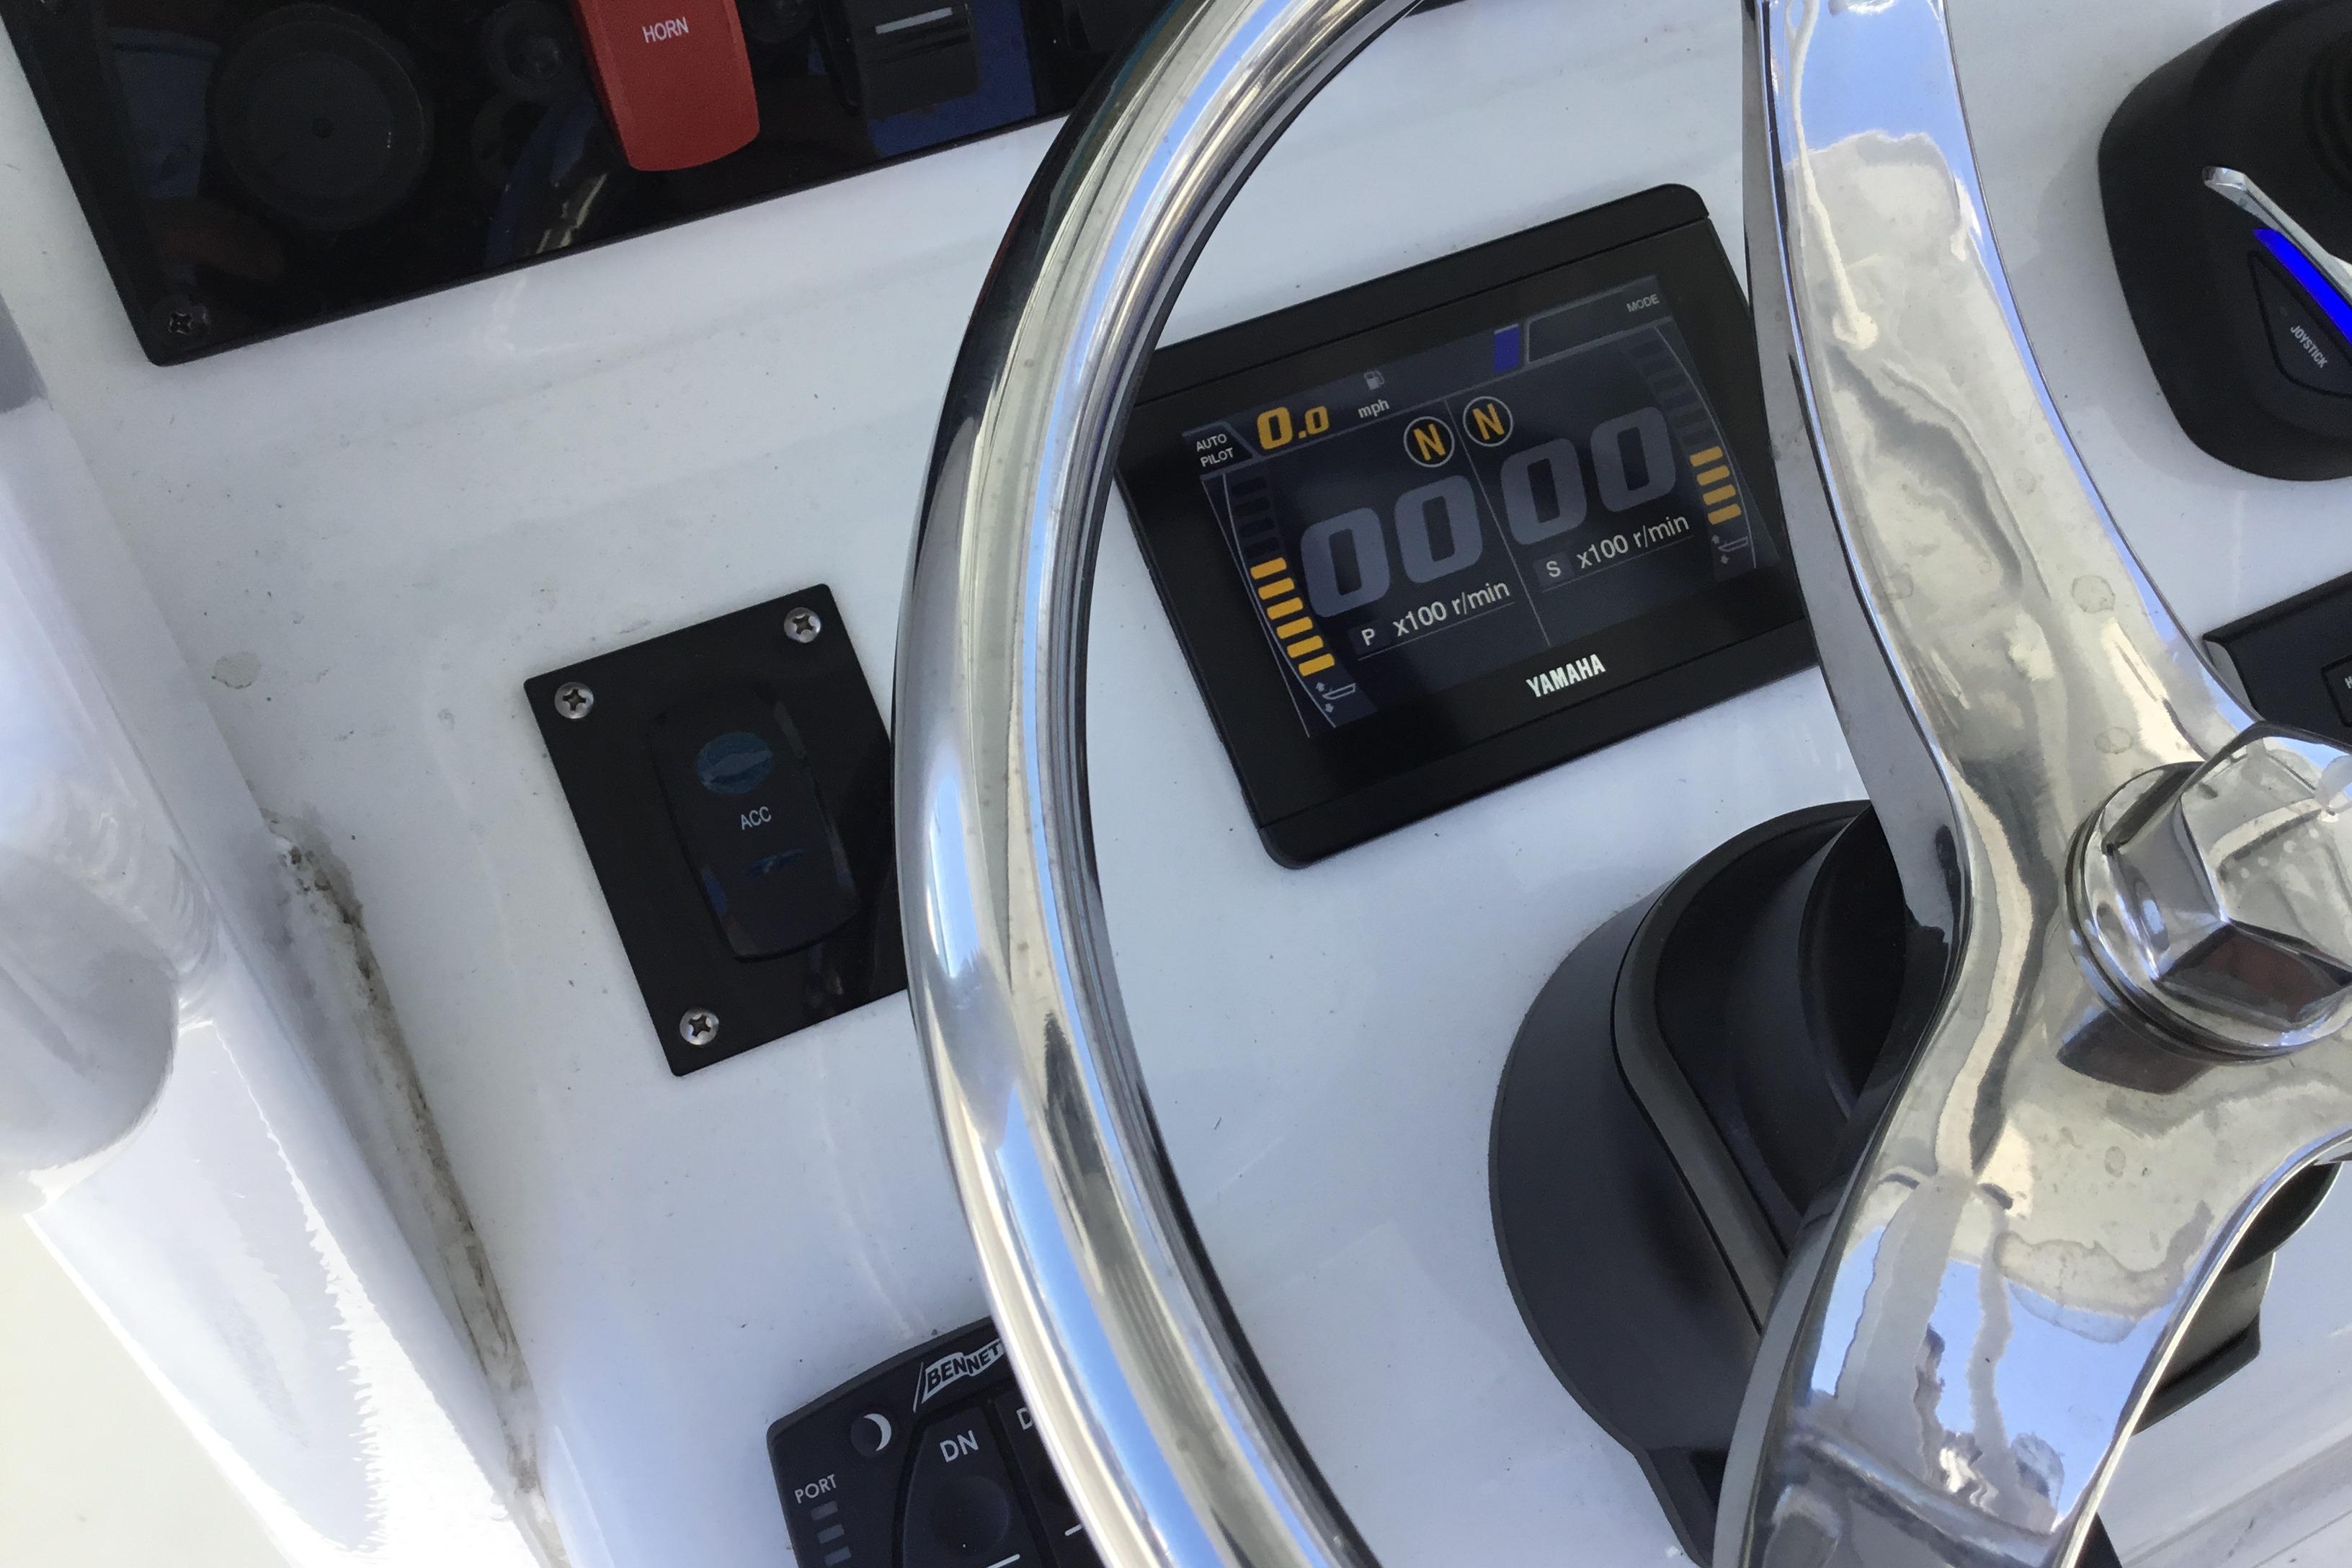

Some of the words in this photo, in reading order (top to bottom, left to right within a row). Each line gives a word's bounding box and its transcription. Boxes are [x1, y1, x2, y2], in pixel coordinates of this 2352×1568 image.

[641, 16, 690, 44] HORN
[1626, 293, 1660, 313] MODE
[2290, 325, 2328, 368] JOYSTICK
[1257, 406, 1329, 450] 0.0
[1358, 398, 1390, 419] mph
[1472, 403, 1505, 440] N
[1196, 433, 1228, 452] AUTO
[1200, 447, 1234, 468] PILOT
[1413, 424, 1446, 460] N
[1545, 560, 1562, 579] S
[1576, 535, 1629, 569] x100
[1633, 512, 1690, 550] r/min
[1361, 628, 1376, 646] P
[1392, 600, 1447, 637] x100
[1451, 579, 1511, 618] r/min
[1525, 653, 1606, 698] YAMAHA
[740, 806, 772, 830] ACC
[926, 1341, 1002, 1394] BENNET
[1016, 1407, 1034, 1430] D
[940, 1430, 979, 1464] DN
[794, 1474, 837, 1504] PORT
